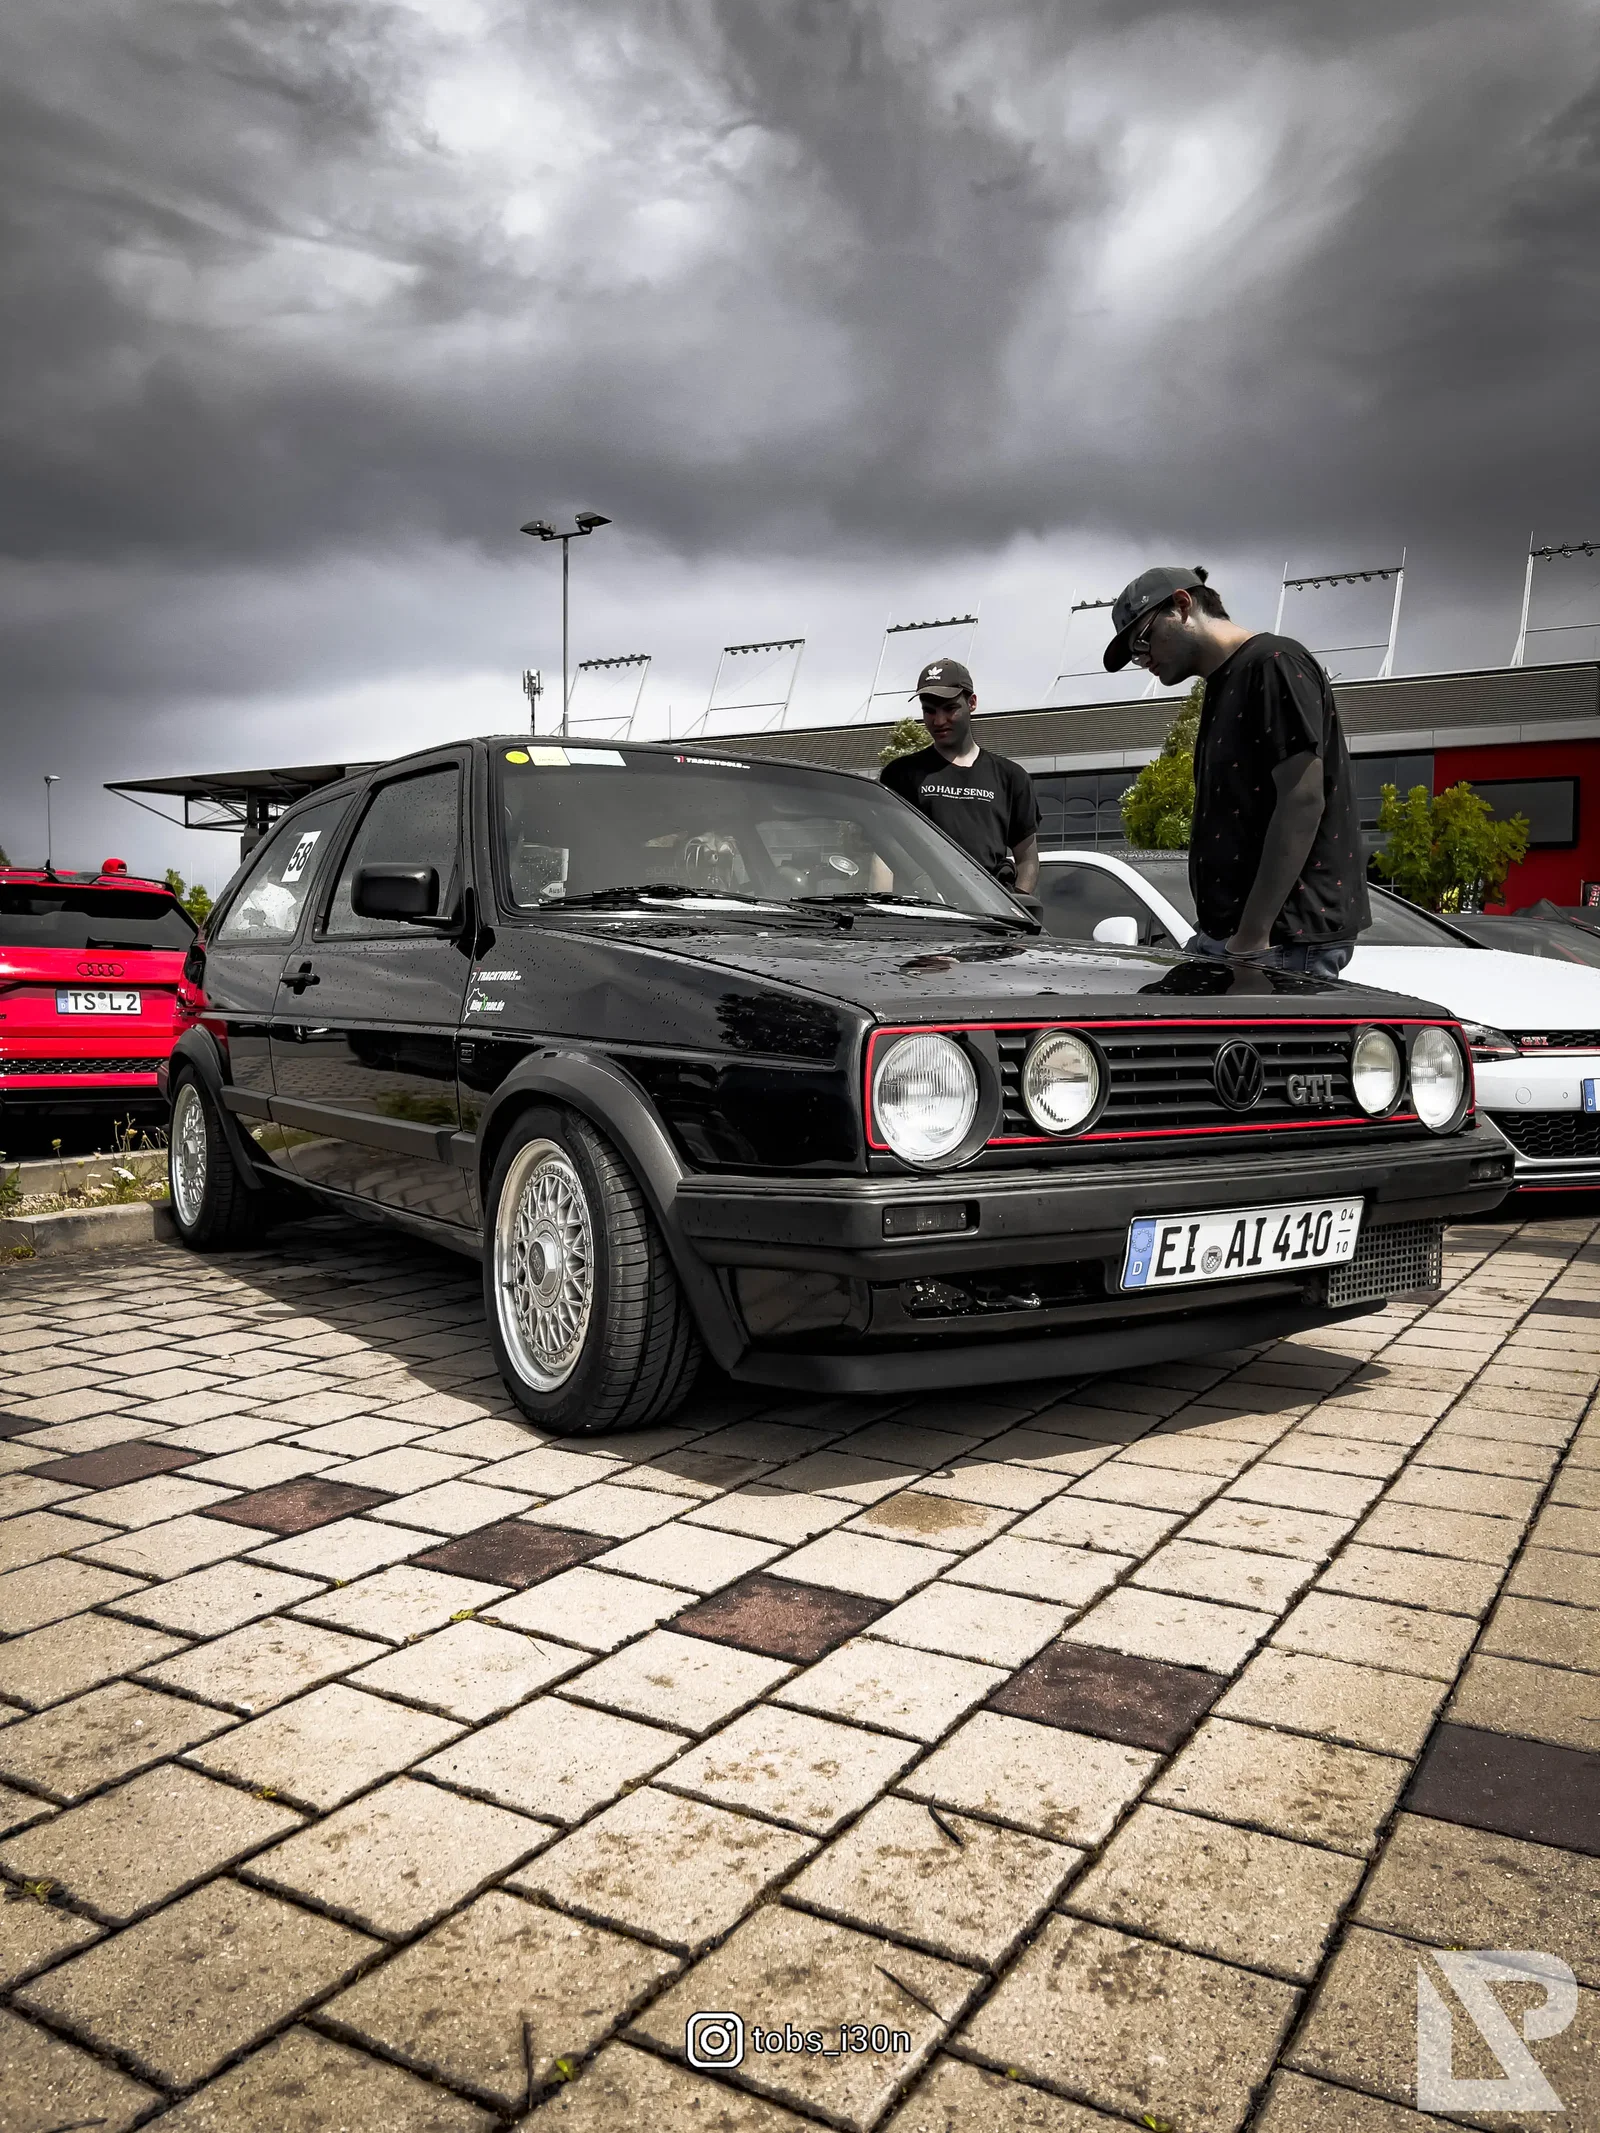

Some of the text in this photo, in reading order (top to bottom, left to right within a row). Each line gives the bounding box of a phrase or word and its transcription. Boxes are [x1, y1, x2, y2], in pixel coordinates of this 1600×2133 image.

[686, 757, 751, 769] TRACKTOOLS
[921, 785, 936, 794] NO
[936, 785, 963, 796] HALF
[963, 787, 995, 800] SENDS
[287, 841, 314, 872] 58
[477, 971, 522, 982] TRACKTOOLS
[69, 992, 96, 1011] TS
[108, 993, 122, 1011] L
[126, 993, 138, 1011] 2
[1521, 1036, 1549, 1046] GTI
[1286, 1073, 1334, 1106] GTI
[1340, 1208, 1354, 1221] 04
[1131, 1209, 1333, 1277] D EI AI 410
[1336, 1240, 1349, 1254] 10
